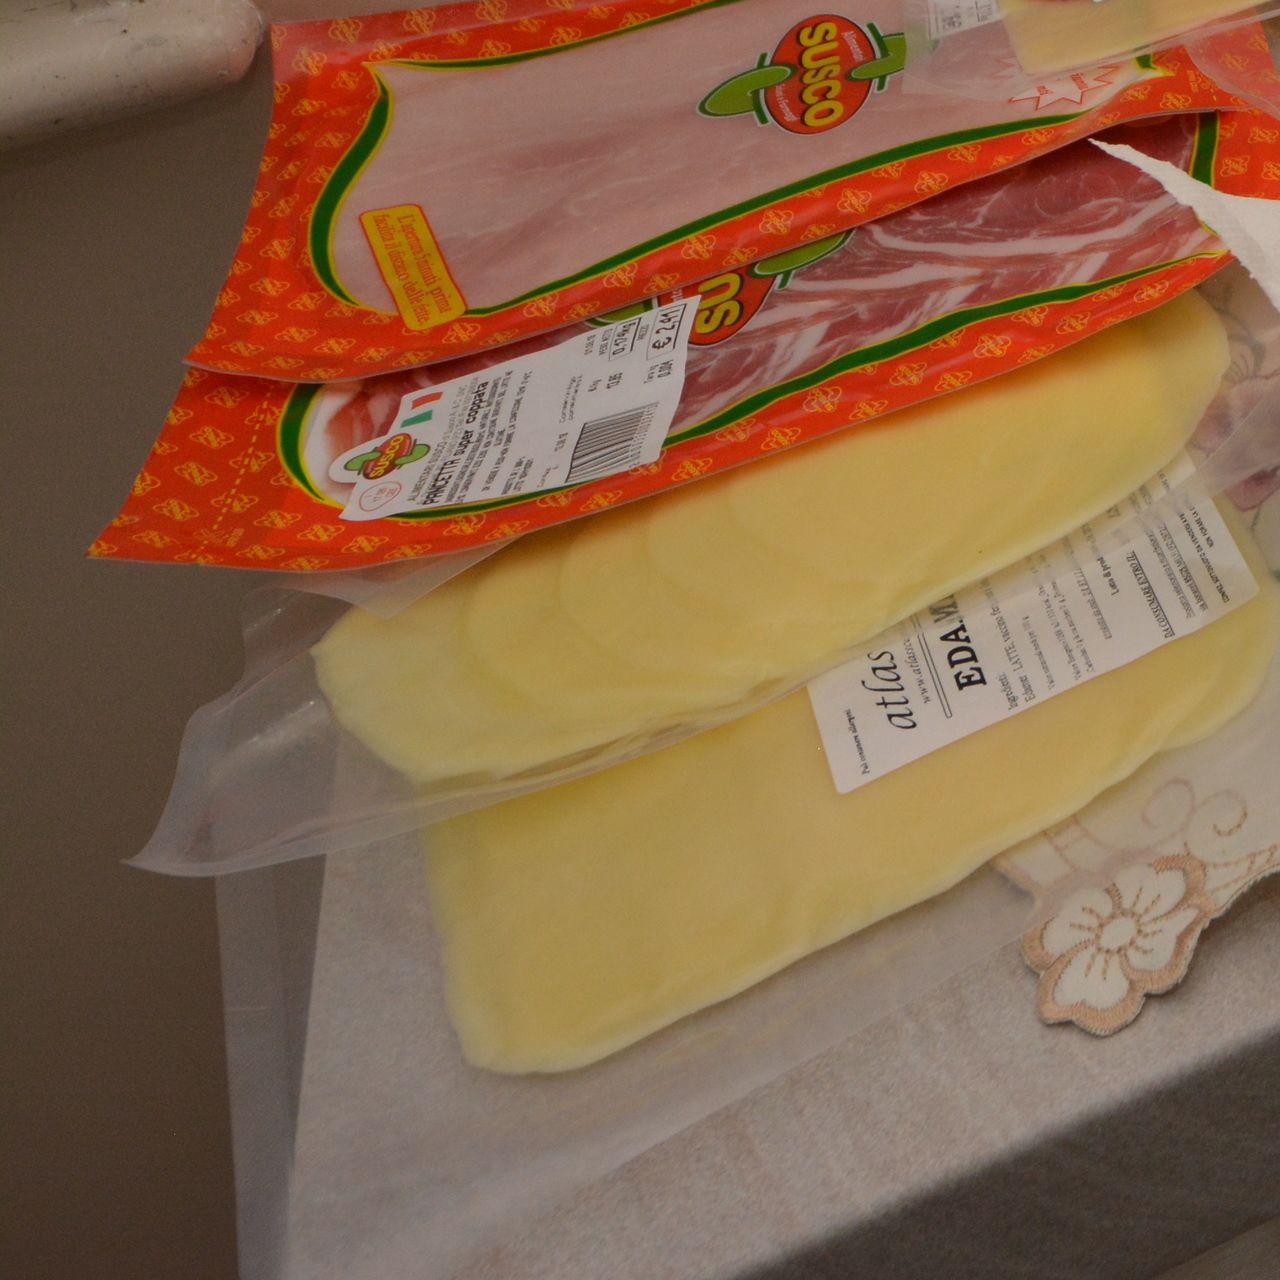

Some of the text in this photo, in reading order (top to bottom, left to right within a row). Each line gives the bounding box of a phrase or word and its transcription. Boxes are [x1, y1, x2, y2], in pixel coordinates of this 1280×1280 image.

[798, 20, 844, 127] SUSCO
[649, 308, 680, 351] € 2,41
[369, 433, 405, 478] SUSCO
[421, 382, 489, 504] PANCETTA super coppata
[860, 647, 918, 727] atlas
